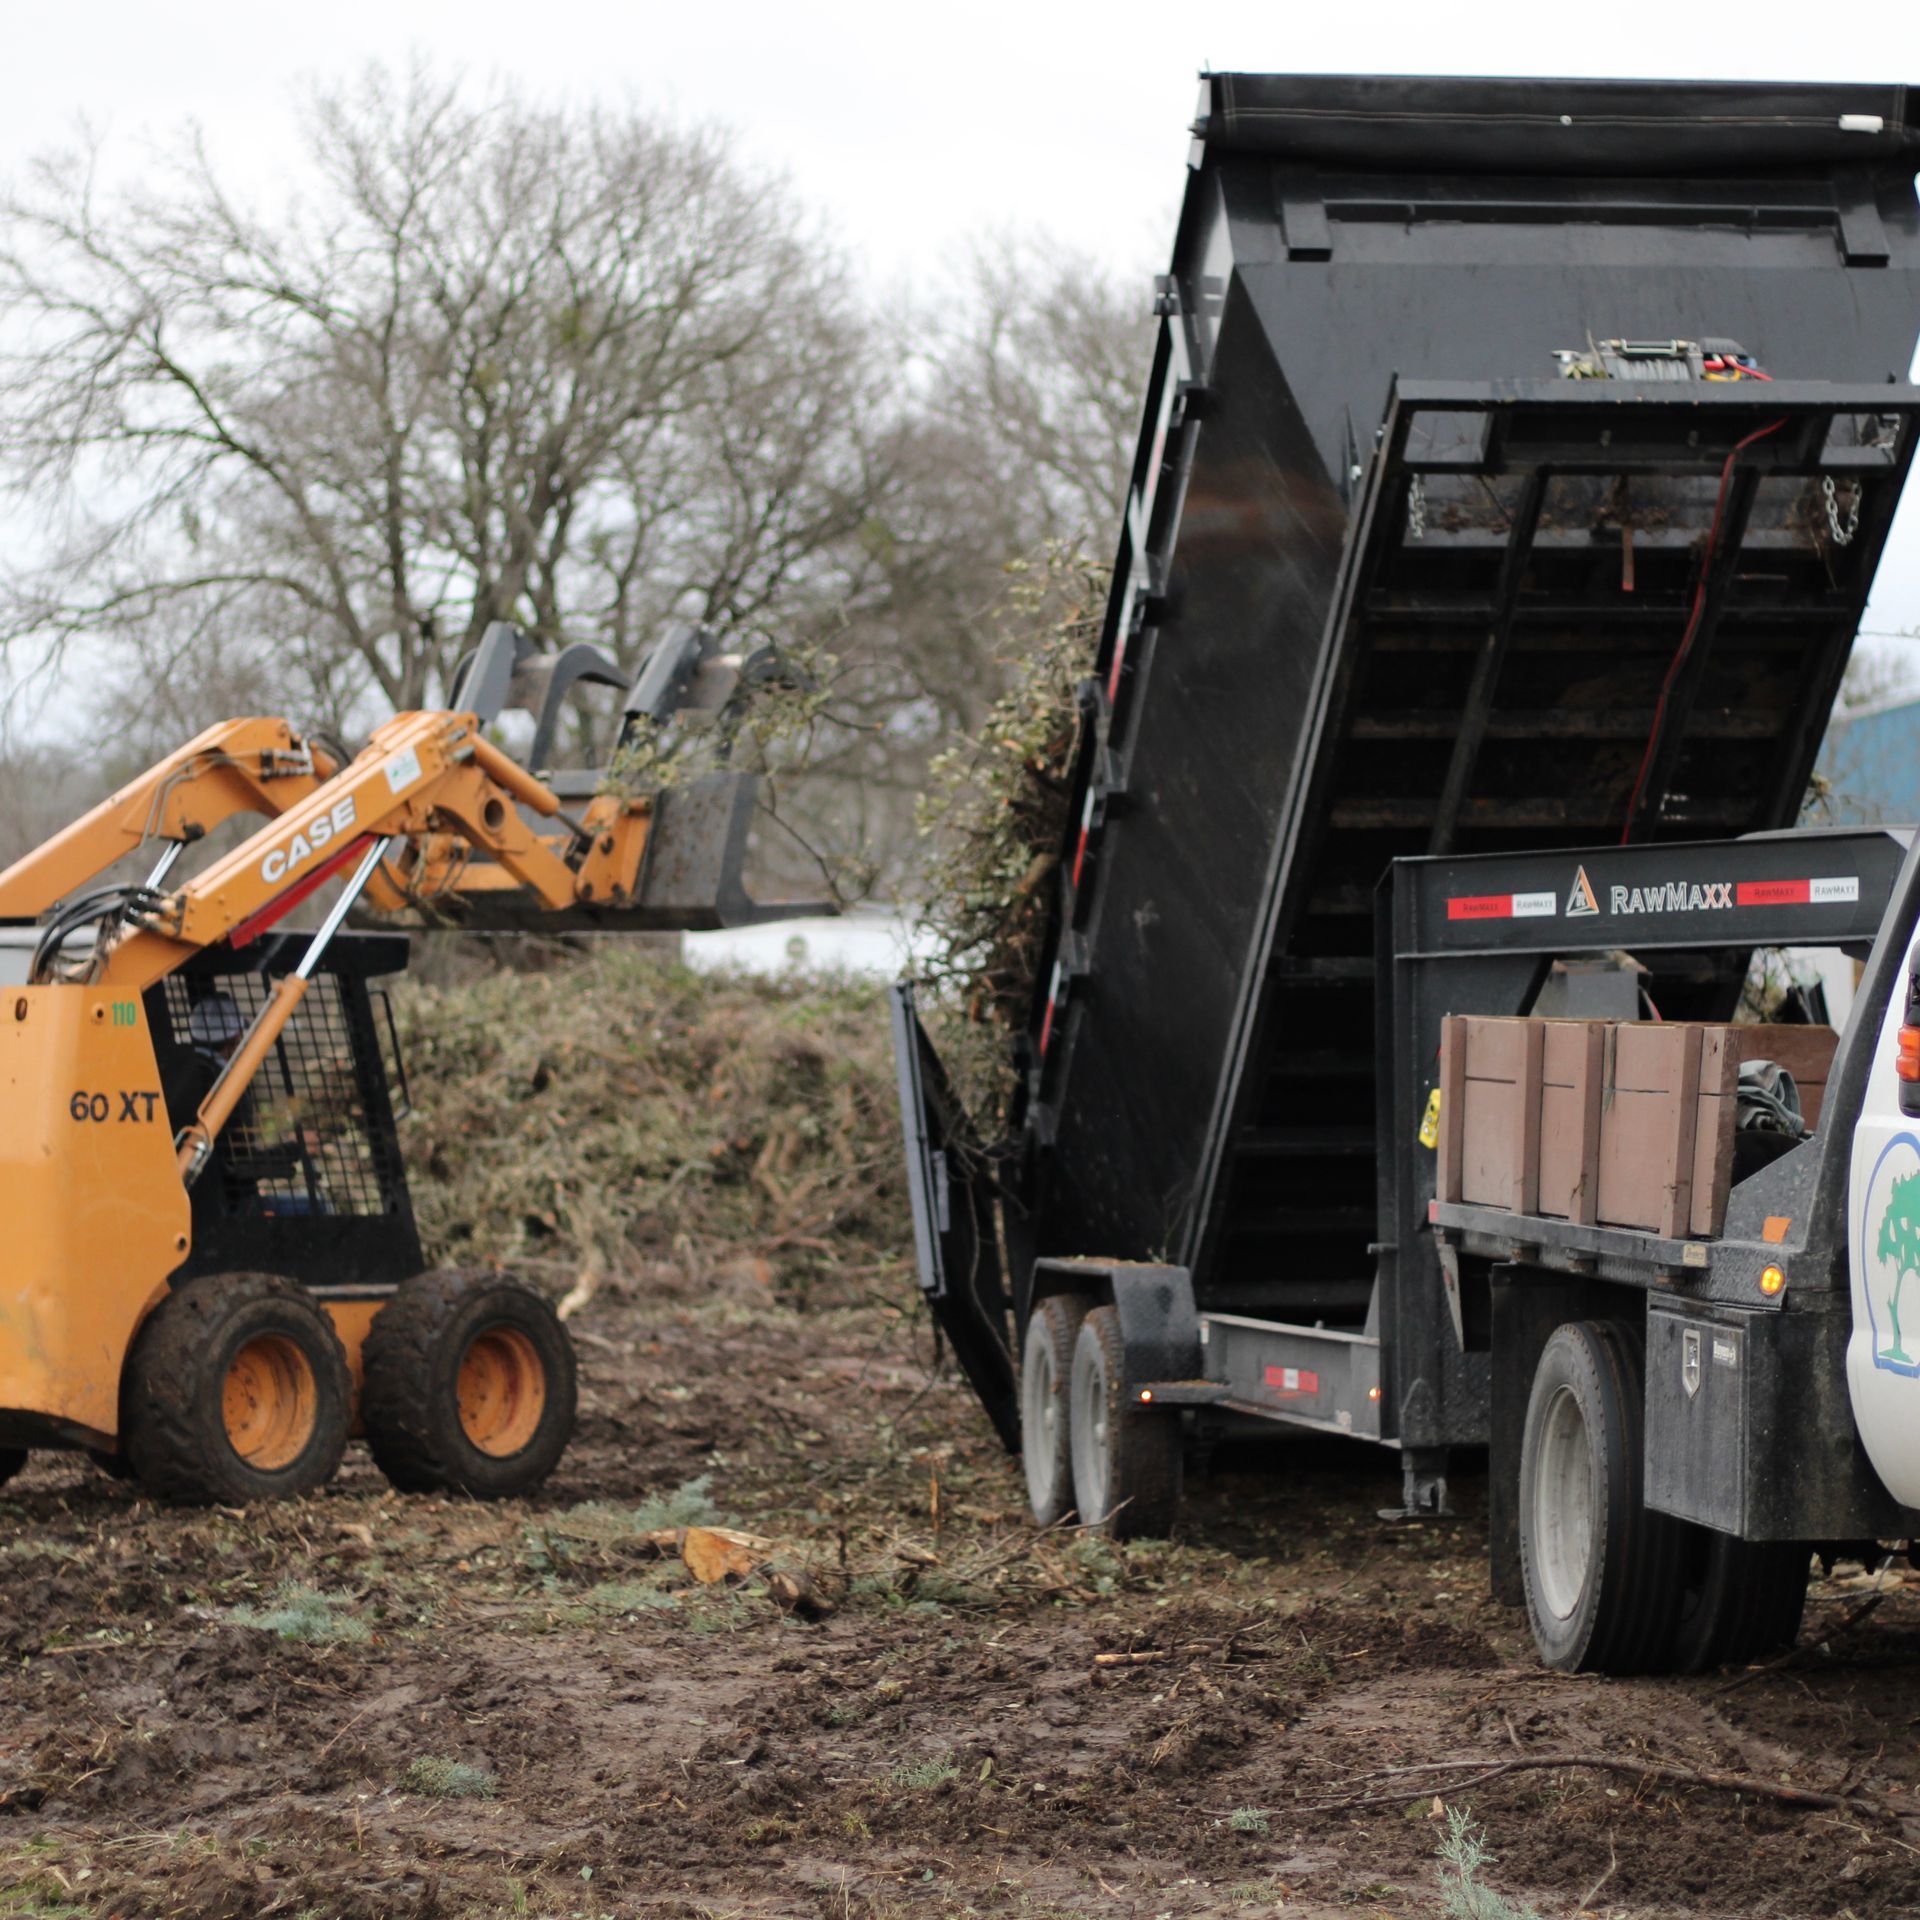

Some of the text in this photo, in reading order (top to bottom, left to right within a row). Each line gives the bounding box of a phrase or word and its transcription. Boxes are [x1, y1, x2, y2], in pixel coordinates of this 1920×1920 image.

[261, 794, 356, 883] CASE
[112, 1002, 136, 1026] 110
[70, 1090, 159, 1122] 60 XT
